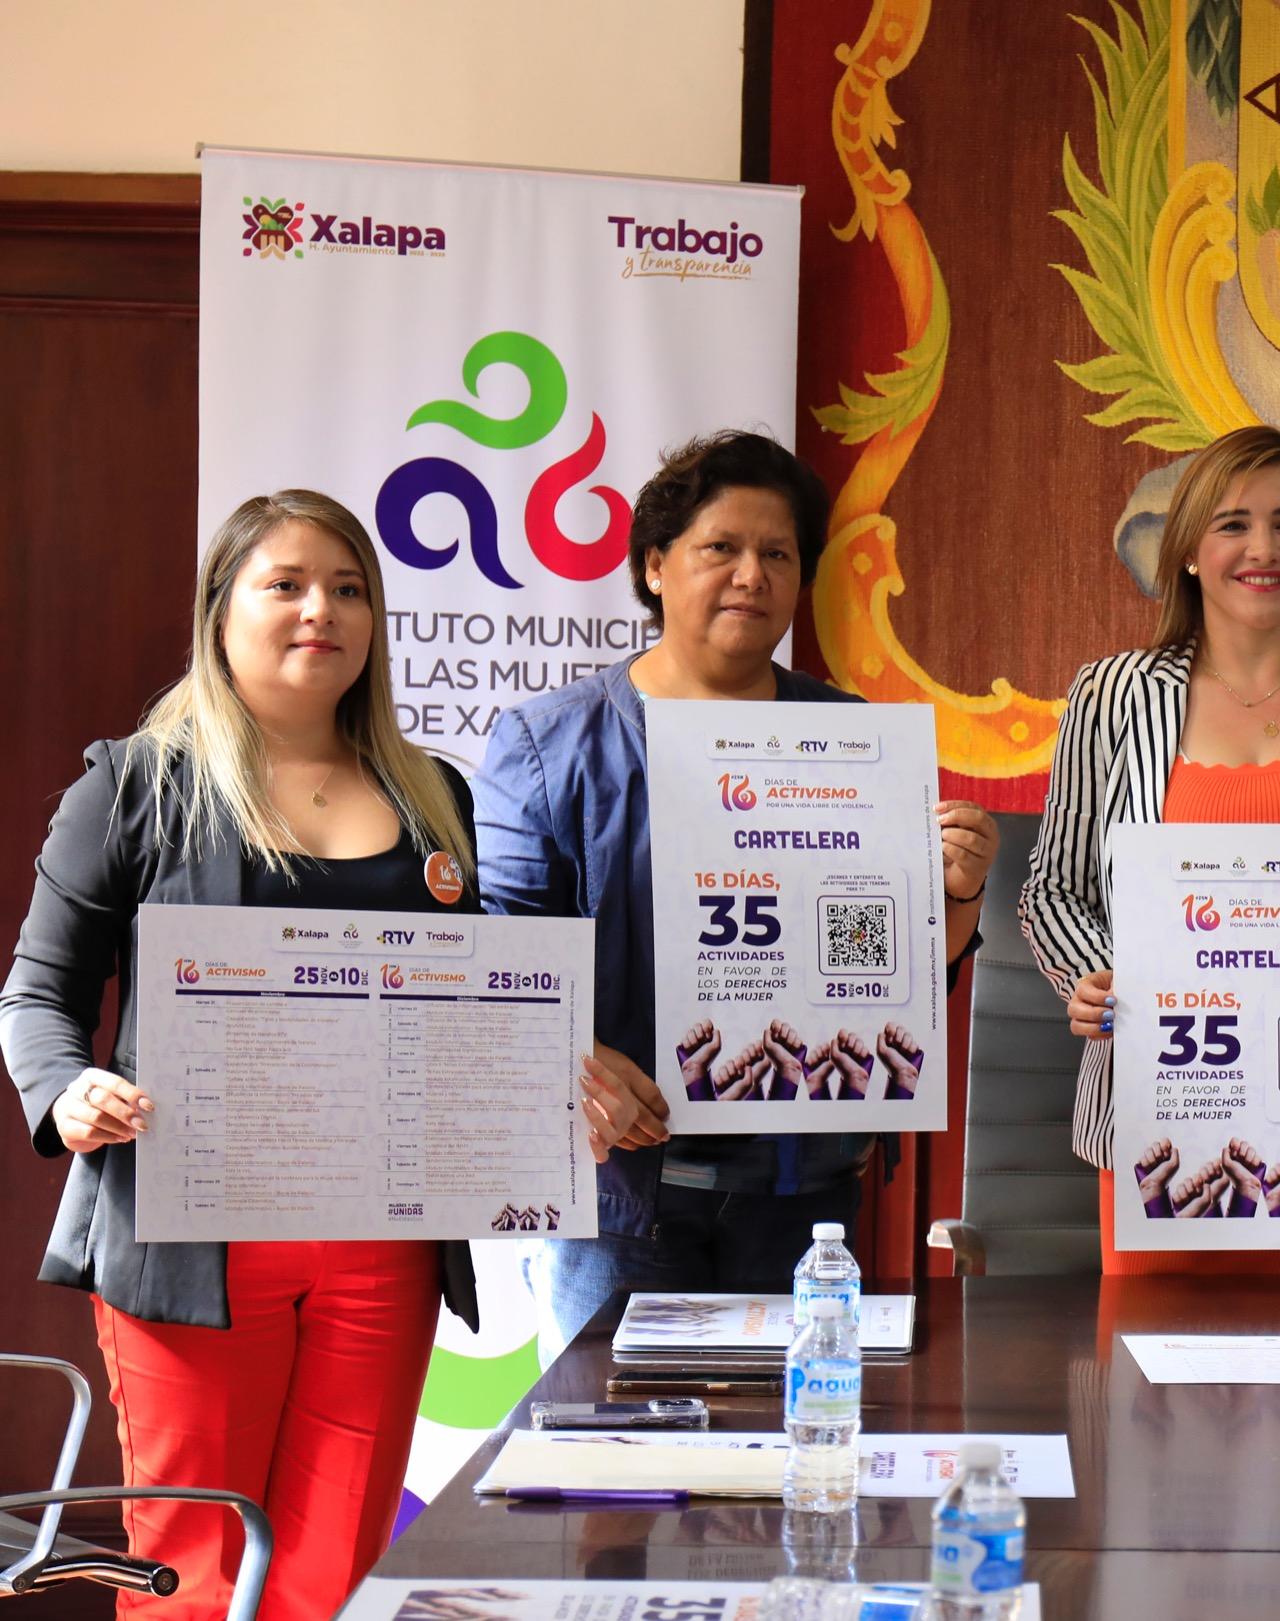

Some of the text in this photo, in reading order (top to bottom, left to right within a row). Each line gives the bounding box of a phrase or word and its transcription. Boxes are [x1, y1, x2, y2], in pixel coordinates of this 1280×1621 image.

[310, 213, 446, 256] Xalapa
[607, 215, 764, 264] Trabajo
[309, 243, 396, 256] H. Ayuntamiento
[639, 245, 752, 282] transparencia
[387, 611, 664, 651] TUTO MUNICIP
[404, 657, 612, 693] LAS MUJE
[394, 704, 445, 736] DE
[729, 741, 755, 750] Xalapa
[800, 741, 828, 753] RTV
[837, 741, 871, 751] Trabajo
[764, 777, 798, 787] DÍAS DE
[766, 787, 858, 800] ACTIVISMO
[734, 830, 860, 850] CARTELERA
[1193, 861, 1221, 871] Xalapa
[695, 869, 781, 891] 16 DÍAS,
[1229, 897, 1263, 906] DÍAS DE
[698, 895, 782, 947] 35
[297, 929, 329, 940] Xalapa
[383, 930, 415, 945] RTV
[426, 931, 465, 942] Trabajo
[697, 951, 785, 961] ACTIVIDADES
[206, 968, 266, 977] ACTIVISMO
[294, 966, 319, 985] 25
[320, 965, 328, 985] NOV.
[339, 968, 360, 985] 10
[361, 970, 369, 985] DIC.
[698, 966, 787, 976] EN FAVOR DE
[410, 973, 466, 983] ACTIVISMO
[488, 972, 512, 990] 25
[513, 971, 521, 990] NOV.
[532, 973, 552, 990] 10
[553, 975, 561, 990] DIC.
[698, 979, 787, 989] LOS DERECHOS
[826, 983, 882, 998] 25 10
[698, 992, 773, 1001] DE LA MUJER
[1155, 989, 1242, 1012] 16 DÍAS,
[1157, 1015, 1242, 1067] 35
[1156, 1070, 1244, 1080] ACTIVIDADES
[1156, 1086, 1246, 1095] EN FAVOR DE
[1156, 1098, 1246, 1108] LOS DERECHOS
[1156, 1111, 1232, 1120] DE LA MUJER
[388, 1208, 424, 1216] #UNIDAS
